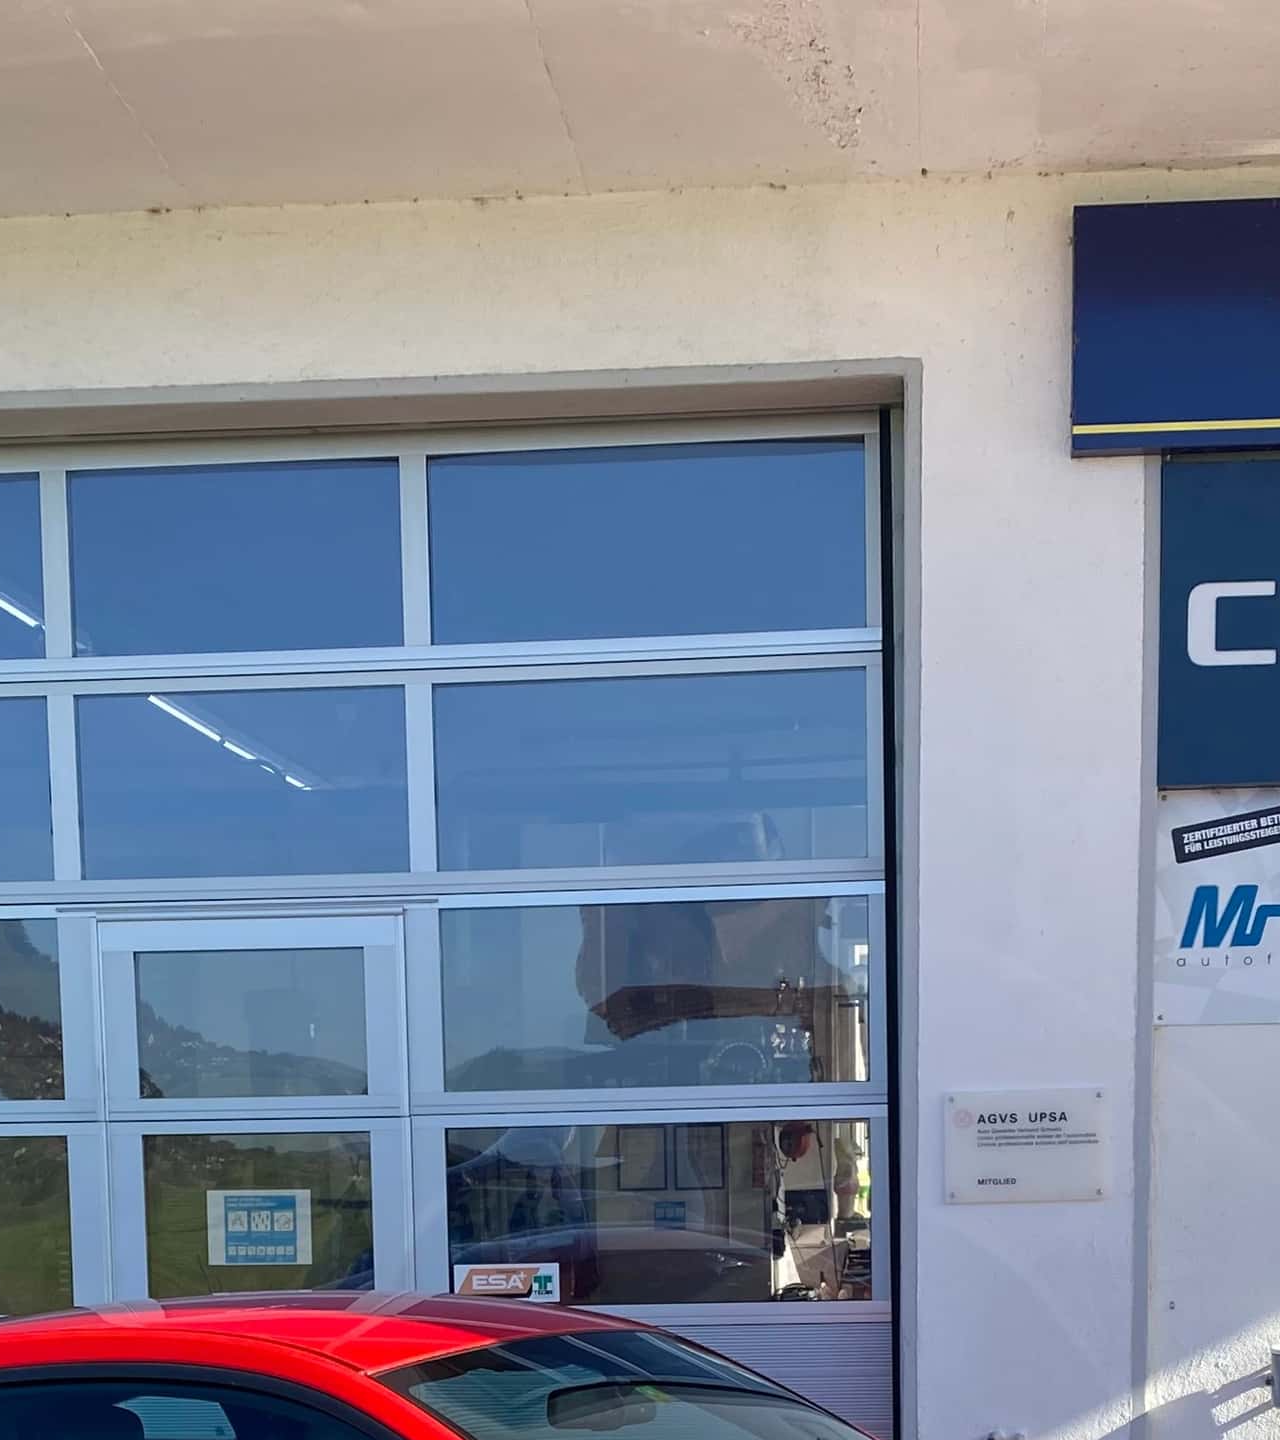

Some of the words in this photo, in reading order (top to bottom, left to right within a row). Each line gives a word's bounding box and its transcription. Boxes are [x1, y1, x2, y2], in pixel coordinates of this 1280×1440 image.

[1182, 818, 1259, 844] ZERTIFIZIERTER
[1184, 841, 1202, 854] FÜR
[977, 1112, 1018, 1124] AGVS
[1028, 1111, 1068, 1123] UPSA
